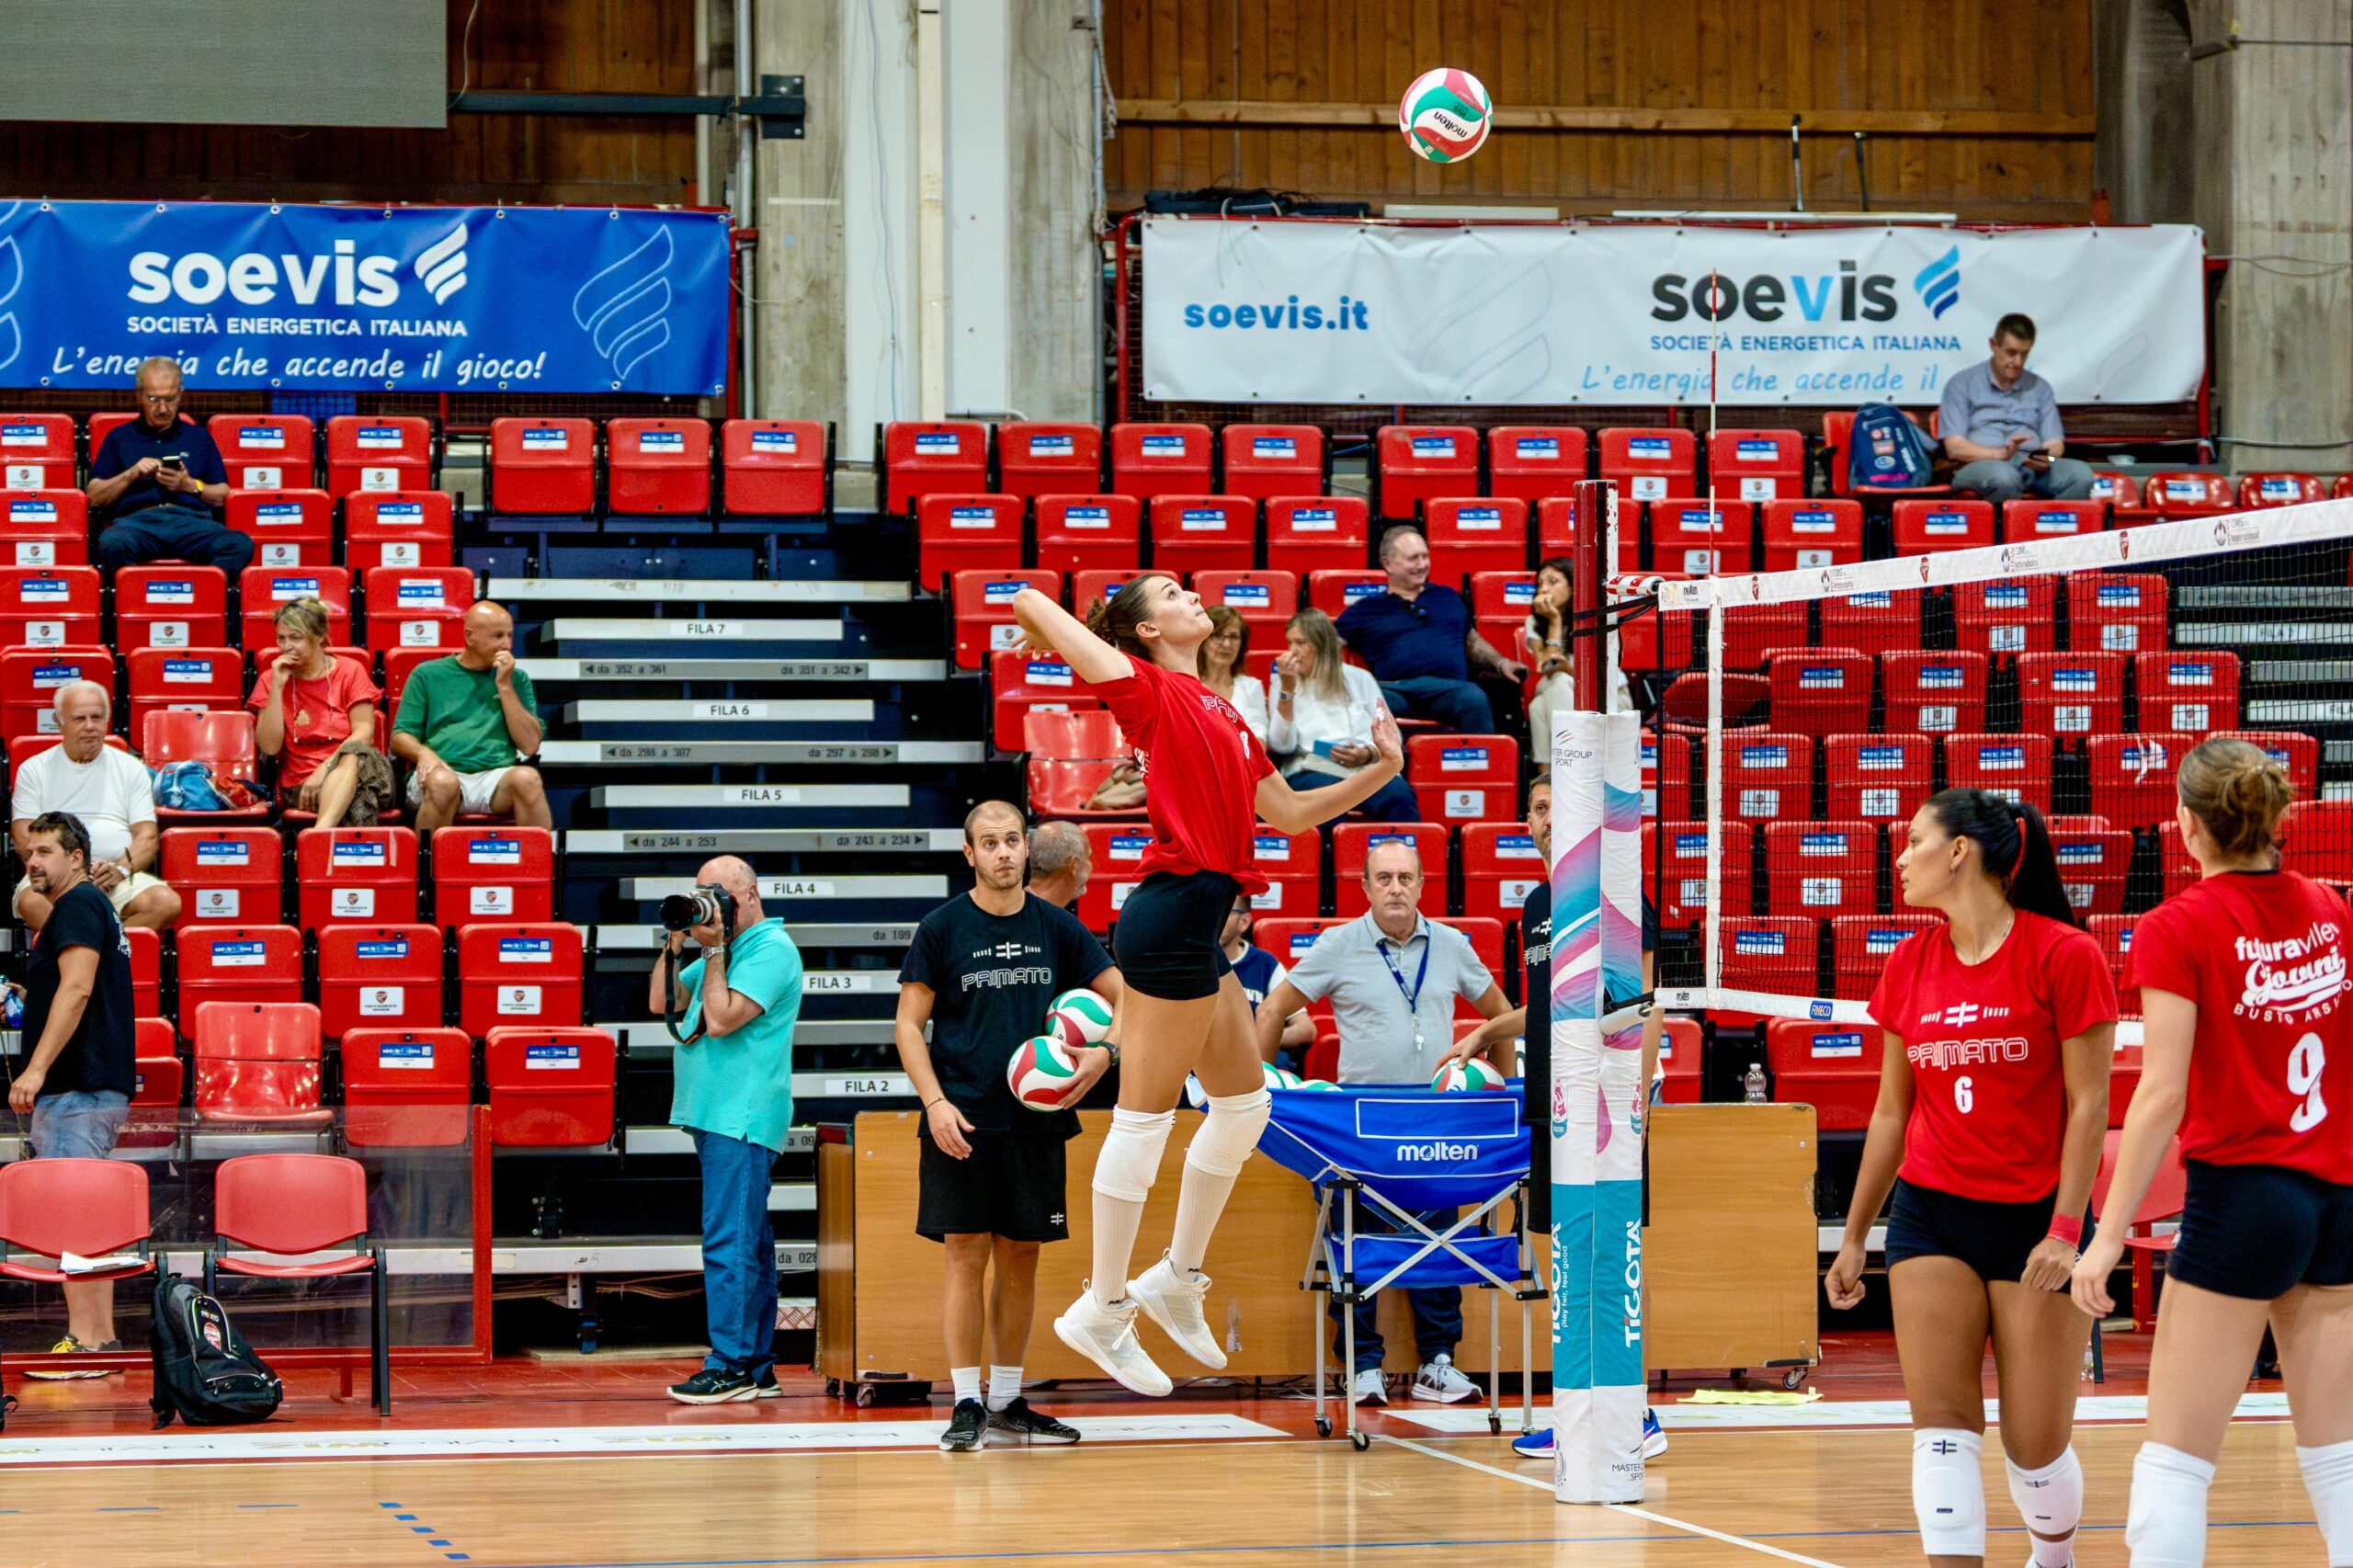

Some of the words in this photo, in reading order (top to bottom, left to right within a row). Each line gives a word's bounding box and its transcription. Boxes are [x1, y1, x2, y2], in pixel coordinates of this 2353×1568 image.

[1434, 111, 1468, 138] molten
[127, 239, 400, 307] soevis
[1650, 259, 1898, 322] soevis
[1184, 295, 1370, 330] soevis.it
[127, 313, 219, 334] SOCIETÀ
[227, 317, 362, 335] ENERGETICA
[370, 319, 468, 336] ITALIANA
[1741, 335, 1865, 351] ENERGETICA
[1873, 335, 1961, 350] ITALIANA
[52, 347, 199, 376] L'eneia
[216, 347, 268, 376] che
[284, 348, 404, 378] accende
[422, 349, 443, 379] il
[457, 351, 547, 385] gioco!
[1732, 365, 1778, 391] che
[1795, 363, 1904, 391] accende
[1919, 364, 1938, 391] il
[687, 623, 715, 634] FILA
[718, 623, 725, 634] 7
[597, 665, 609, 674] da
[780, 665, 793, 675] da
[821, 666, 827, 675] a
[710, 705, 738, 716] FILA
[742, 705, 749, 716] 6
[620, 748, 631, 757] da
[662, 749, 668, 757] a
[809, 748, 821, 757] da
[826, 748, 845, 757] 297
[849, 749, 857, 757] a
[1563, 749, 1592, 759] GROUP
[1554, 757, 1574, 767] PORT
[742, 790, 770, 801] FILA
[773, 790, 781, 801] 5
[642, 837, 655, 846] da
[661, 837, 679, 846] 244
[686, 838, 692, 846] a
[698, 837, 717, 846] 253
[836, 835, 849, 846] da
[855, 835, 874, 846] 243
[892, 835, 910, 846] 234
[774, 883, 802, 893] FILA
[806, 883, 816, 893] 4
[872, 930, 886, 940] da
[892, 930, 911, 940] 189
[809, 978, 840, 989] FILA
[844, 978, 851, 989] 3
[961, 967, 1051, 992] PRIMATO
[2234, 1002, 2294, 1026] BUSTO
[1907, 1037, 2029, 1072] PRIMATO
[846, 1081, 877, 1092] FILA
[881, 1081, 888, 1092] 2
[2287, 1031, 2328, 1132] 9
[1954, 1075, 1973, 1114] 6
[801, 1135, 815, 1146] 09
[1397, 1142, 1478, 1161] molten
[778, 1252, 792, 1264] da
